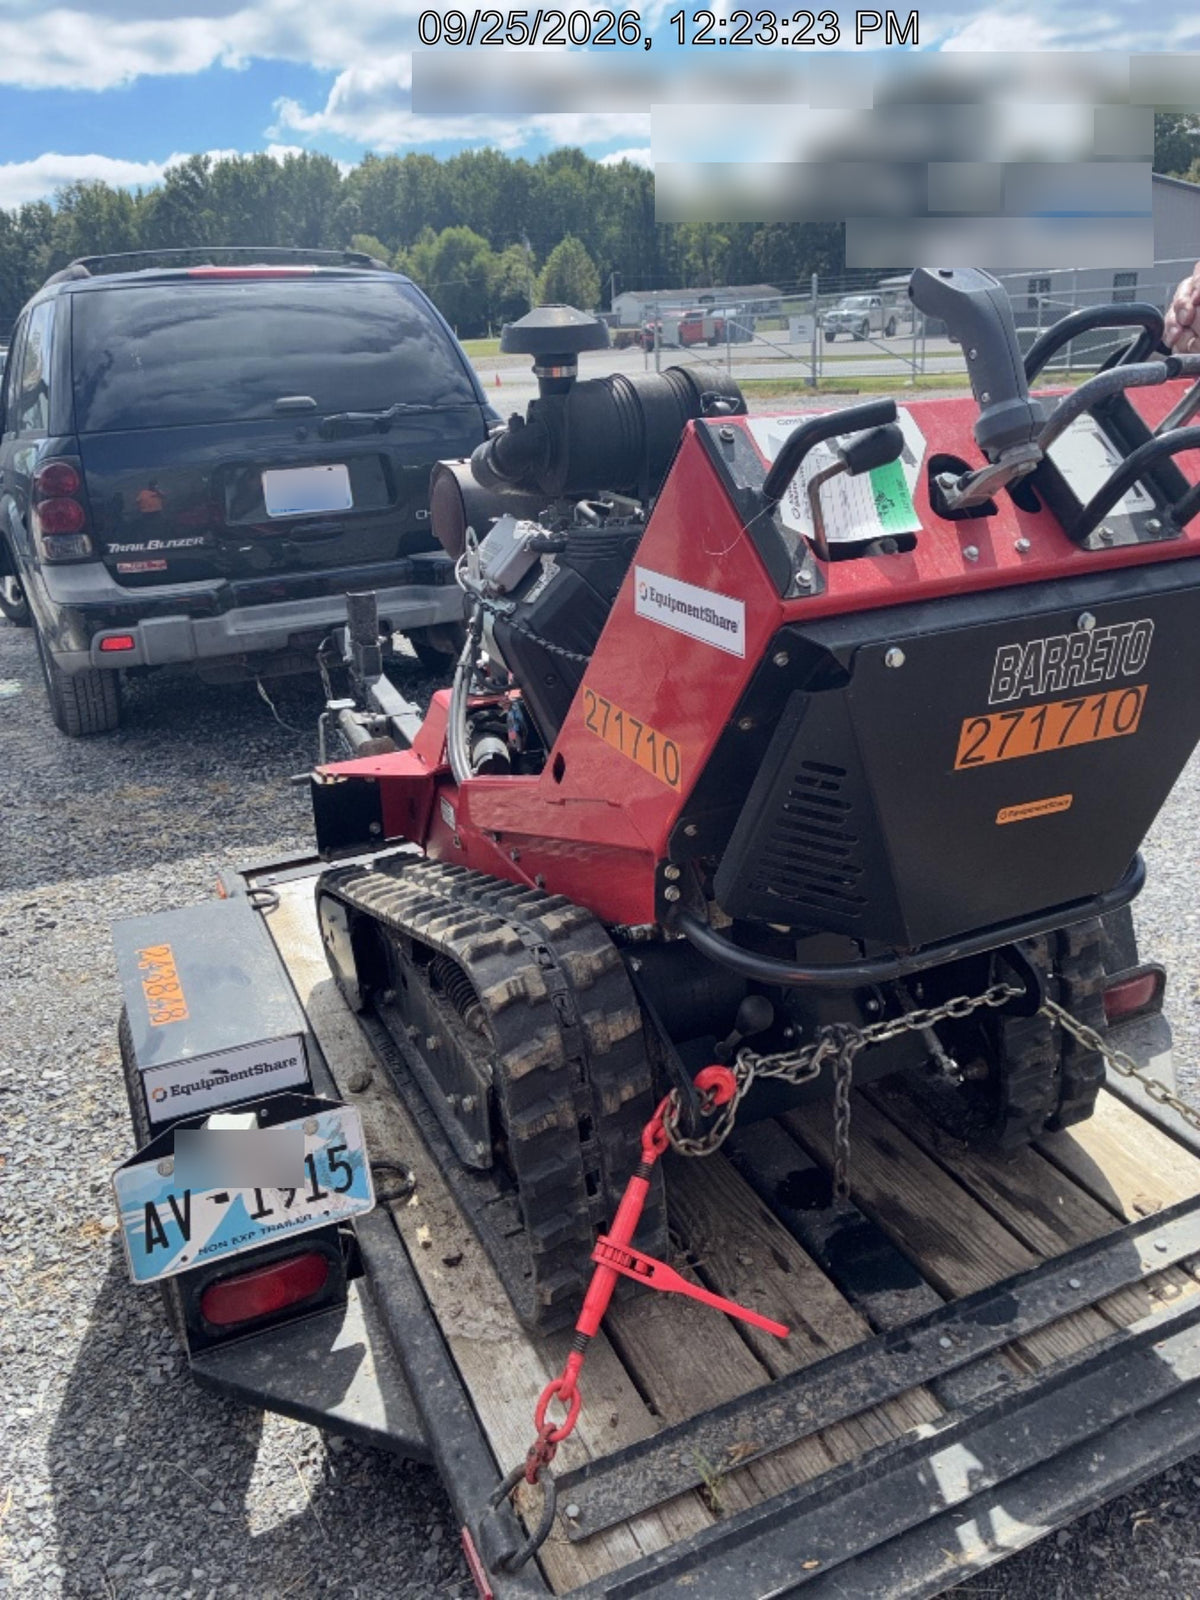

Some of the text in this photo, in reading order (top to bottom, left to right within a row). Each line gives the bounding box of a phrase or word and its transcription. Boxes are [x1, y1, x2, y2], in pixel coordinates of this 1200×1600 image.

[649, 586, 739, 634] EquipmentShare
[988, 618, 1155, 705] BARRETO
[584, 689, 680, 786] 271710
[959, 687, 1143, 766] 271710
[169, 1056, 298, 1097] EquipmentShare
[144, 1189, 191, 1254] AV
[198, 1240, 228, 1256] NON
[260, 1213, 312, 1235] TRAILER
